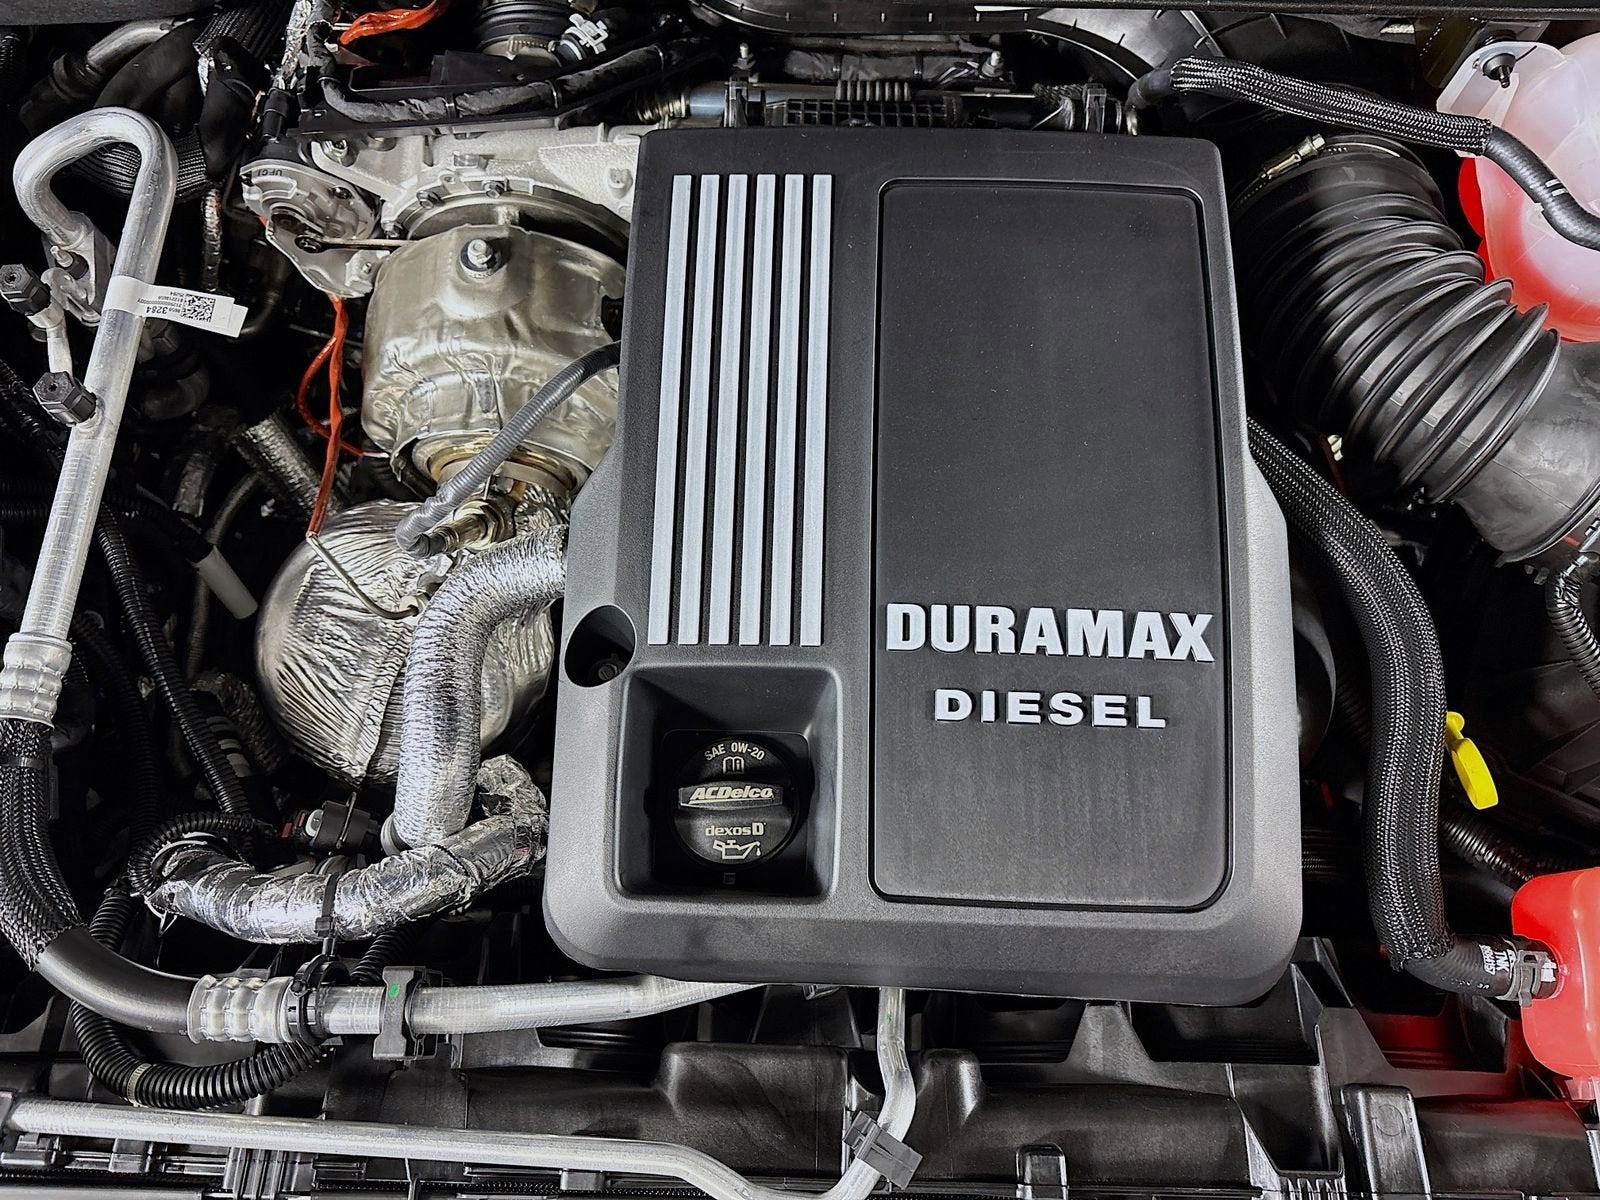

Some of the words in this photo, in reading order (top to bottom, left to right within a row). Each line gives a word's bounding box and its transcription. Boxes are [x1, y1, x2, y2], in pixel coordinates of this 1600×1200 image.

[146, 306, 168, 314] 3284
[886, 603, 1215, 662] DURAMAX
[934, 689, 1166, 728] DIESEL
[704, 743, 726, 761] SAE
[730, 741, 765, 760] 0W-20
[688, 785, 774, 801] ACDelco
